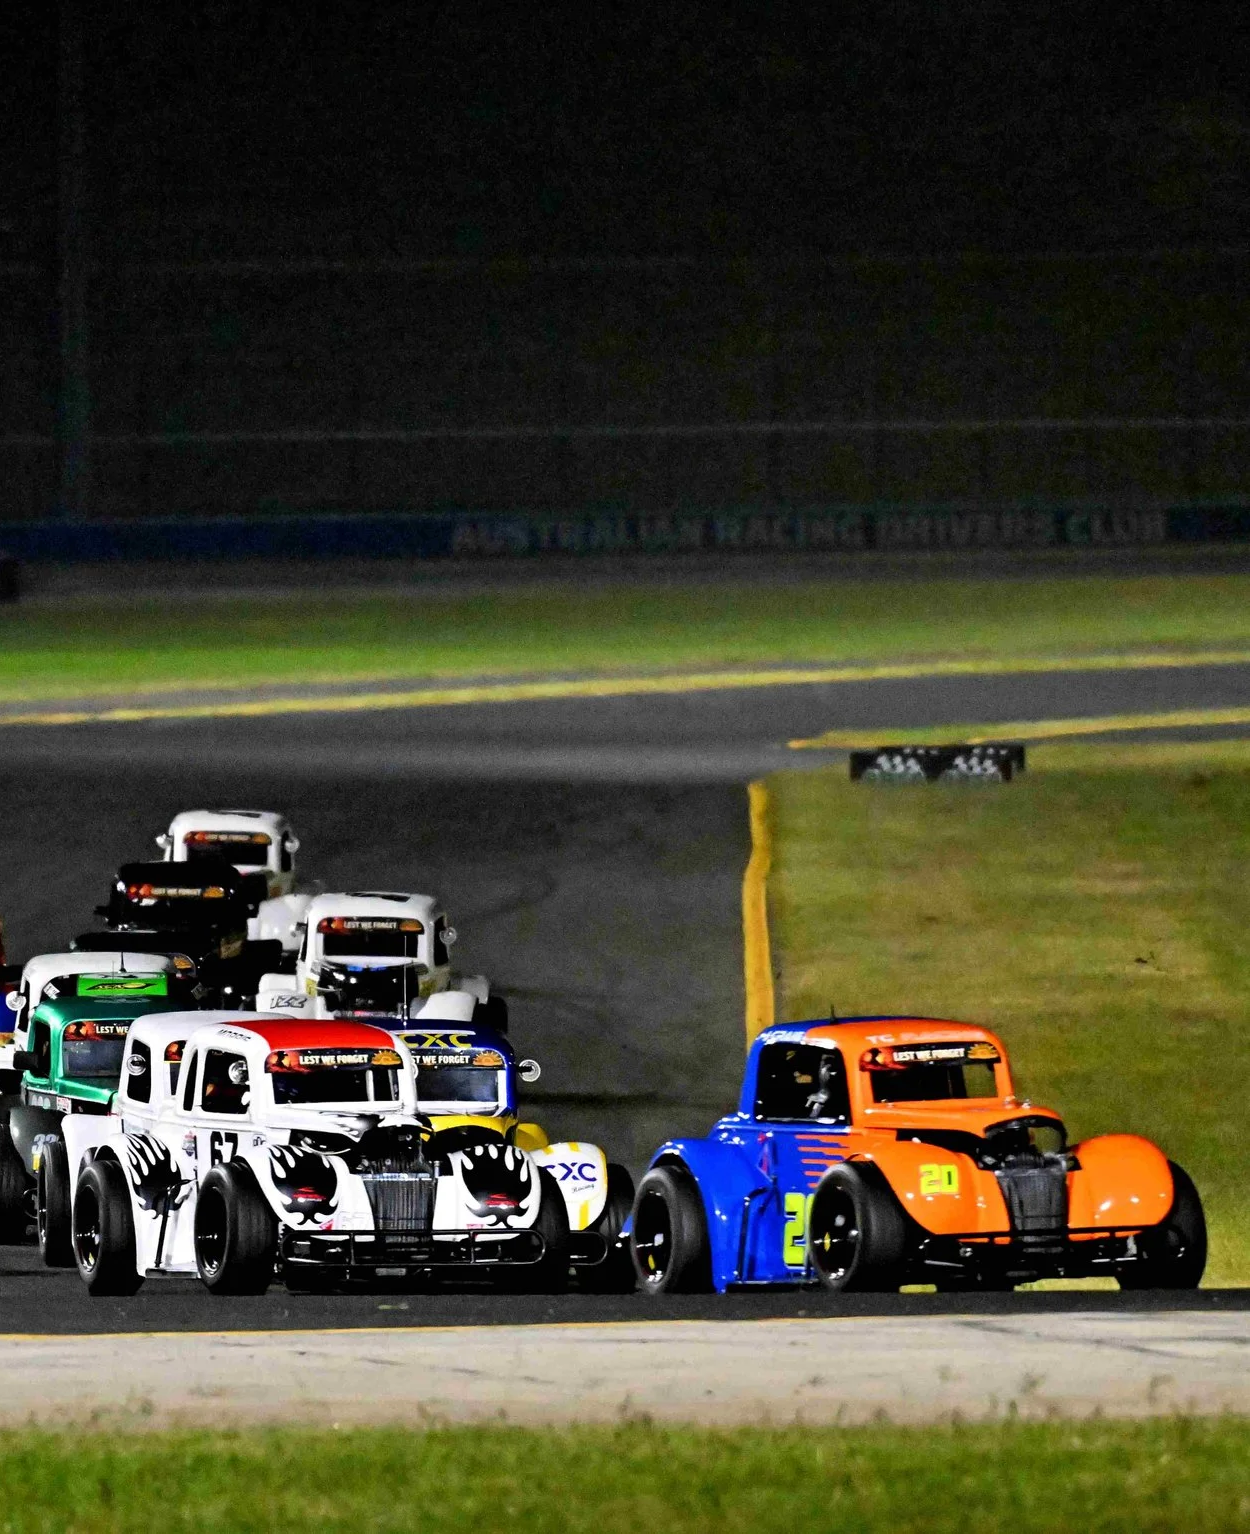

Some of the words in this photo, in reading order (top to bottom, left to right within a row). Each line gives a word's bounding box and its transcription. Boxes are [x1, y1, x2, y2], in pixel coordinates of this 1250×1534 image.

[96, 1025, 115, 1034] LEST
[116, 1026, 129, 1035] WE
[399, 1034, 472, 1048] CXC
[299, 1055, 320, 1065] LEST
[321, 1055, 336, 1065] WE
[336, 1054, 368, 1064] FORGET
[422, 1055, 437, 1064] WE
[438, 1055, 470, 1064] FORGET
[893, 1052, 915, 1062] LEST
[210, 1131, 238, 1169] 67
[920, 1164, 959, 1195] 20
